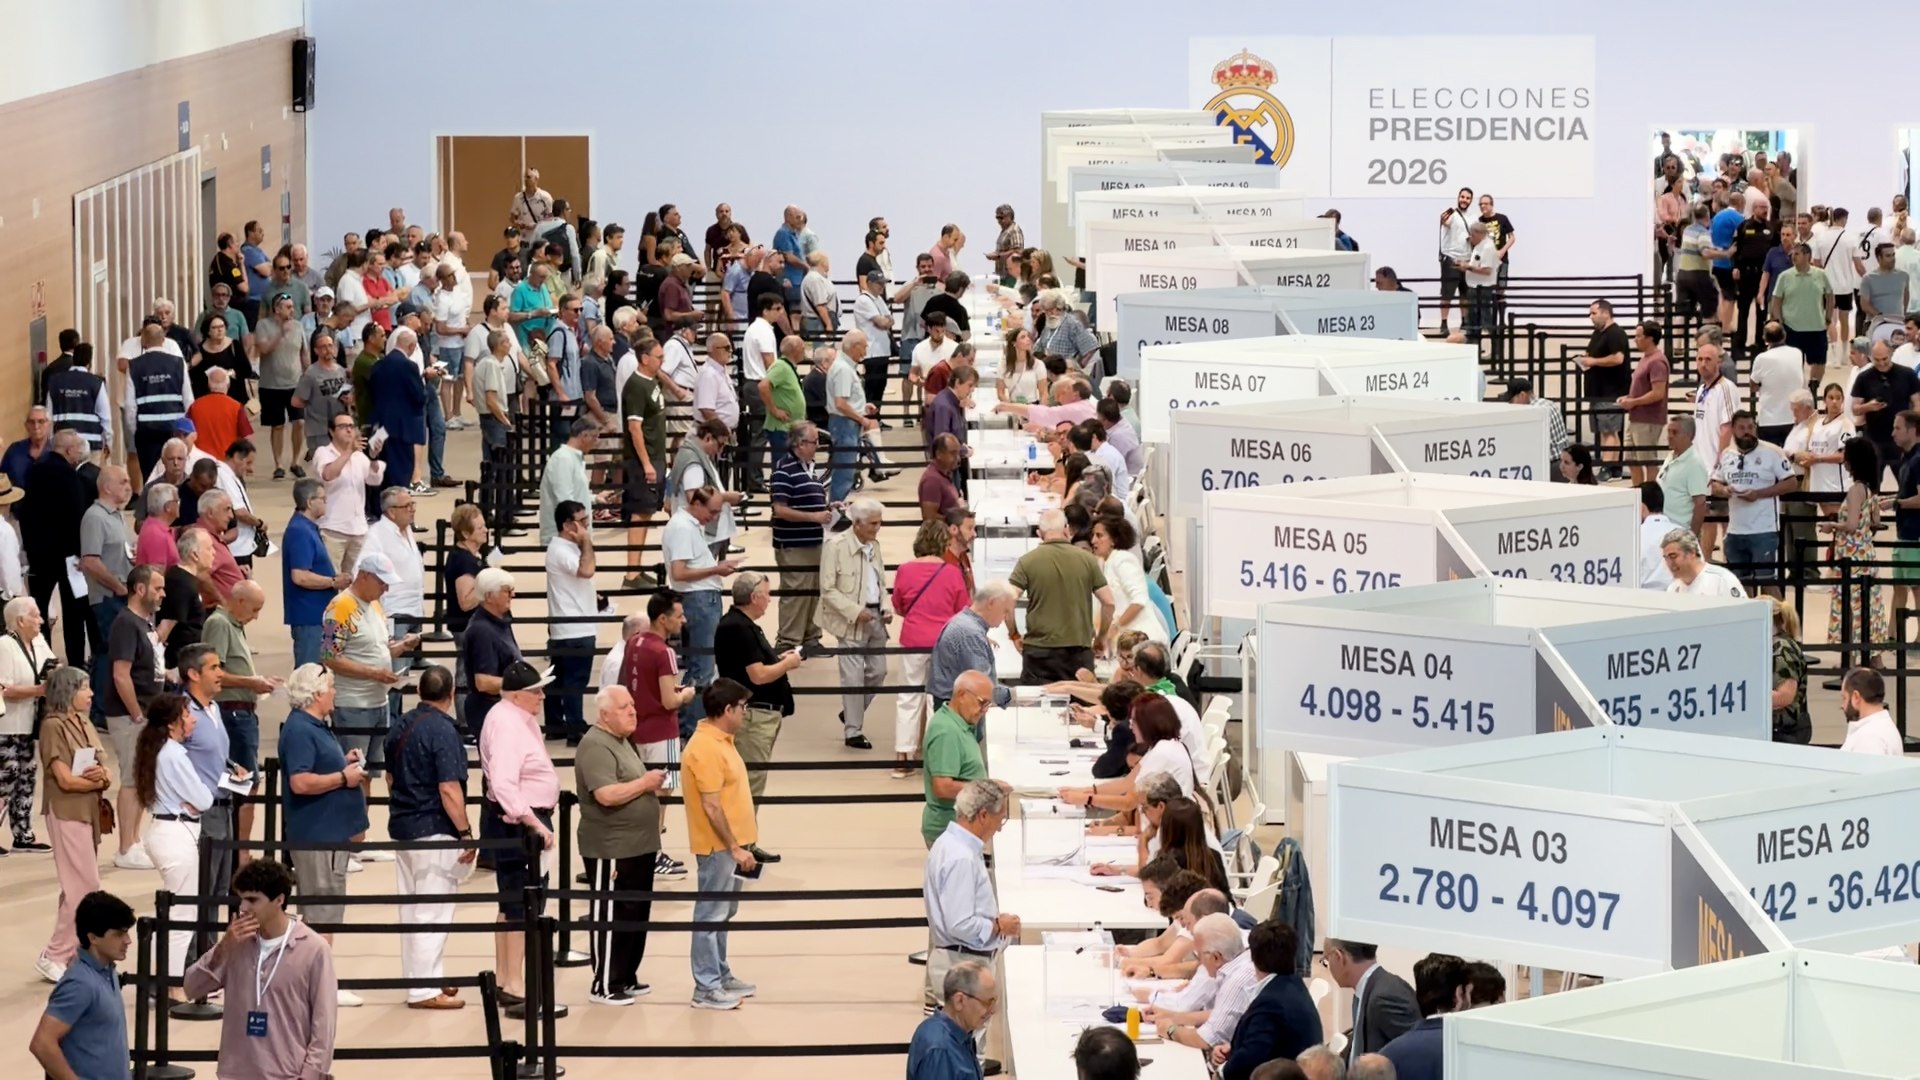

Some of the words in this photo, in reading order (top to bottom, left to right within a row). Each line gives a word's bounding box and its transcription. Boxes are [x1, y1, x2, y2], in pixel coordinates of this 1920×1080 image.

[1369, 88, 1590, 109] ELECCIONES
[1369, 117, 1589, 141] PRESIDENCIA
[1367, 158, 1448, 185] 2026
[1101, 181, 1130, 191] MESA
[1112, 208, 1144, 219] MESA
[1124, 238, 1159, 251] MESA
[1286, 237, 1298, 249] 21
[1140, 274, 1178, 290] MESA
[1182, 276, 1197, 290] 09
[1277, 274, 1312, 287] MESA
[1316, 273, 1330, 288] 22
[1165, 315, 1208, 333] MESA
[1212, 318, 1229, 334] 08
[1318, 316, 1356, 333] MESA
[1360, 315, 1375, 331] 23
[1195, 372, 1242, 391] MESA
[1248, 375, 1266, 392] 07
[1366, 372, 1408, 392] MESA
[1413, 371, 1429, 388] 24
[1231, 438, 1285, 461] MESA
[1291, 443, 1312, 462] 06
[1425, 440, 1472, 462] MESA
[1478, 437, 1496, 457] 25
[1274, 526, 1336, 552] MESA
[1343, 532, 1367, 555] 05
[1498, 528, 1553, 555] MESA
[1559, 525, 1580, 548] 26
[1240, 560, 1307, 592] 5.416
[1333, 568, 1402, 594] 6.705
[1341, 644, 1415, 677] MESA
[1424, 653, 1453, 680] 04
[1607, 647, 1671, 680] MESA
[1677, 643, 1702, 671] 27
[1300, 684, 1382, 723] 4.098
[1412, 695, 1495, 735] 5.415
[1668, 680, 1746, 722] 35.141
[1430, 816, 1522, 858] MESA
[1532, 830, 1568, 864] 03
[1757, 822, 1832, 864] MESA
[1841, 817, 1870, 851] 28
[1379, 863, 1479, 913] 2.780
[1517, 881, 1620, 931] 4.097
